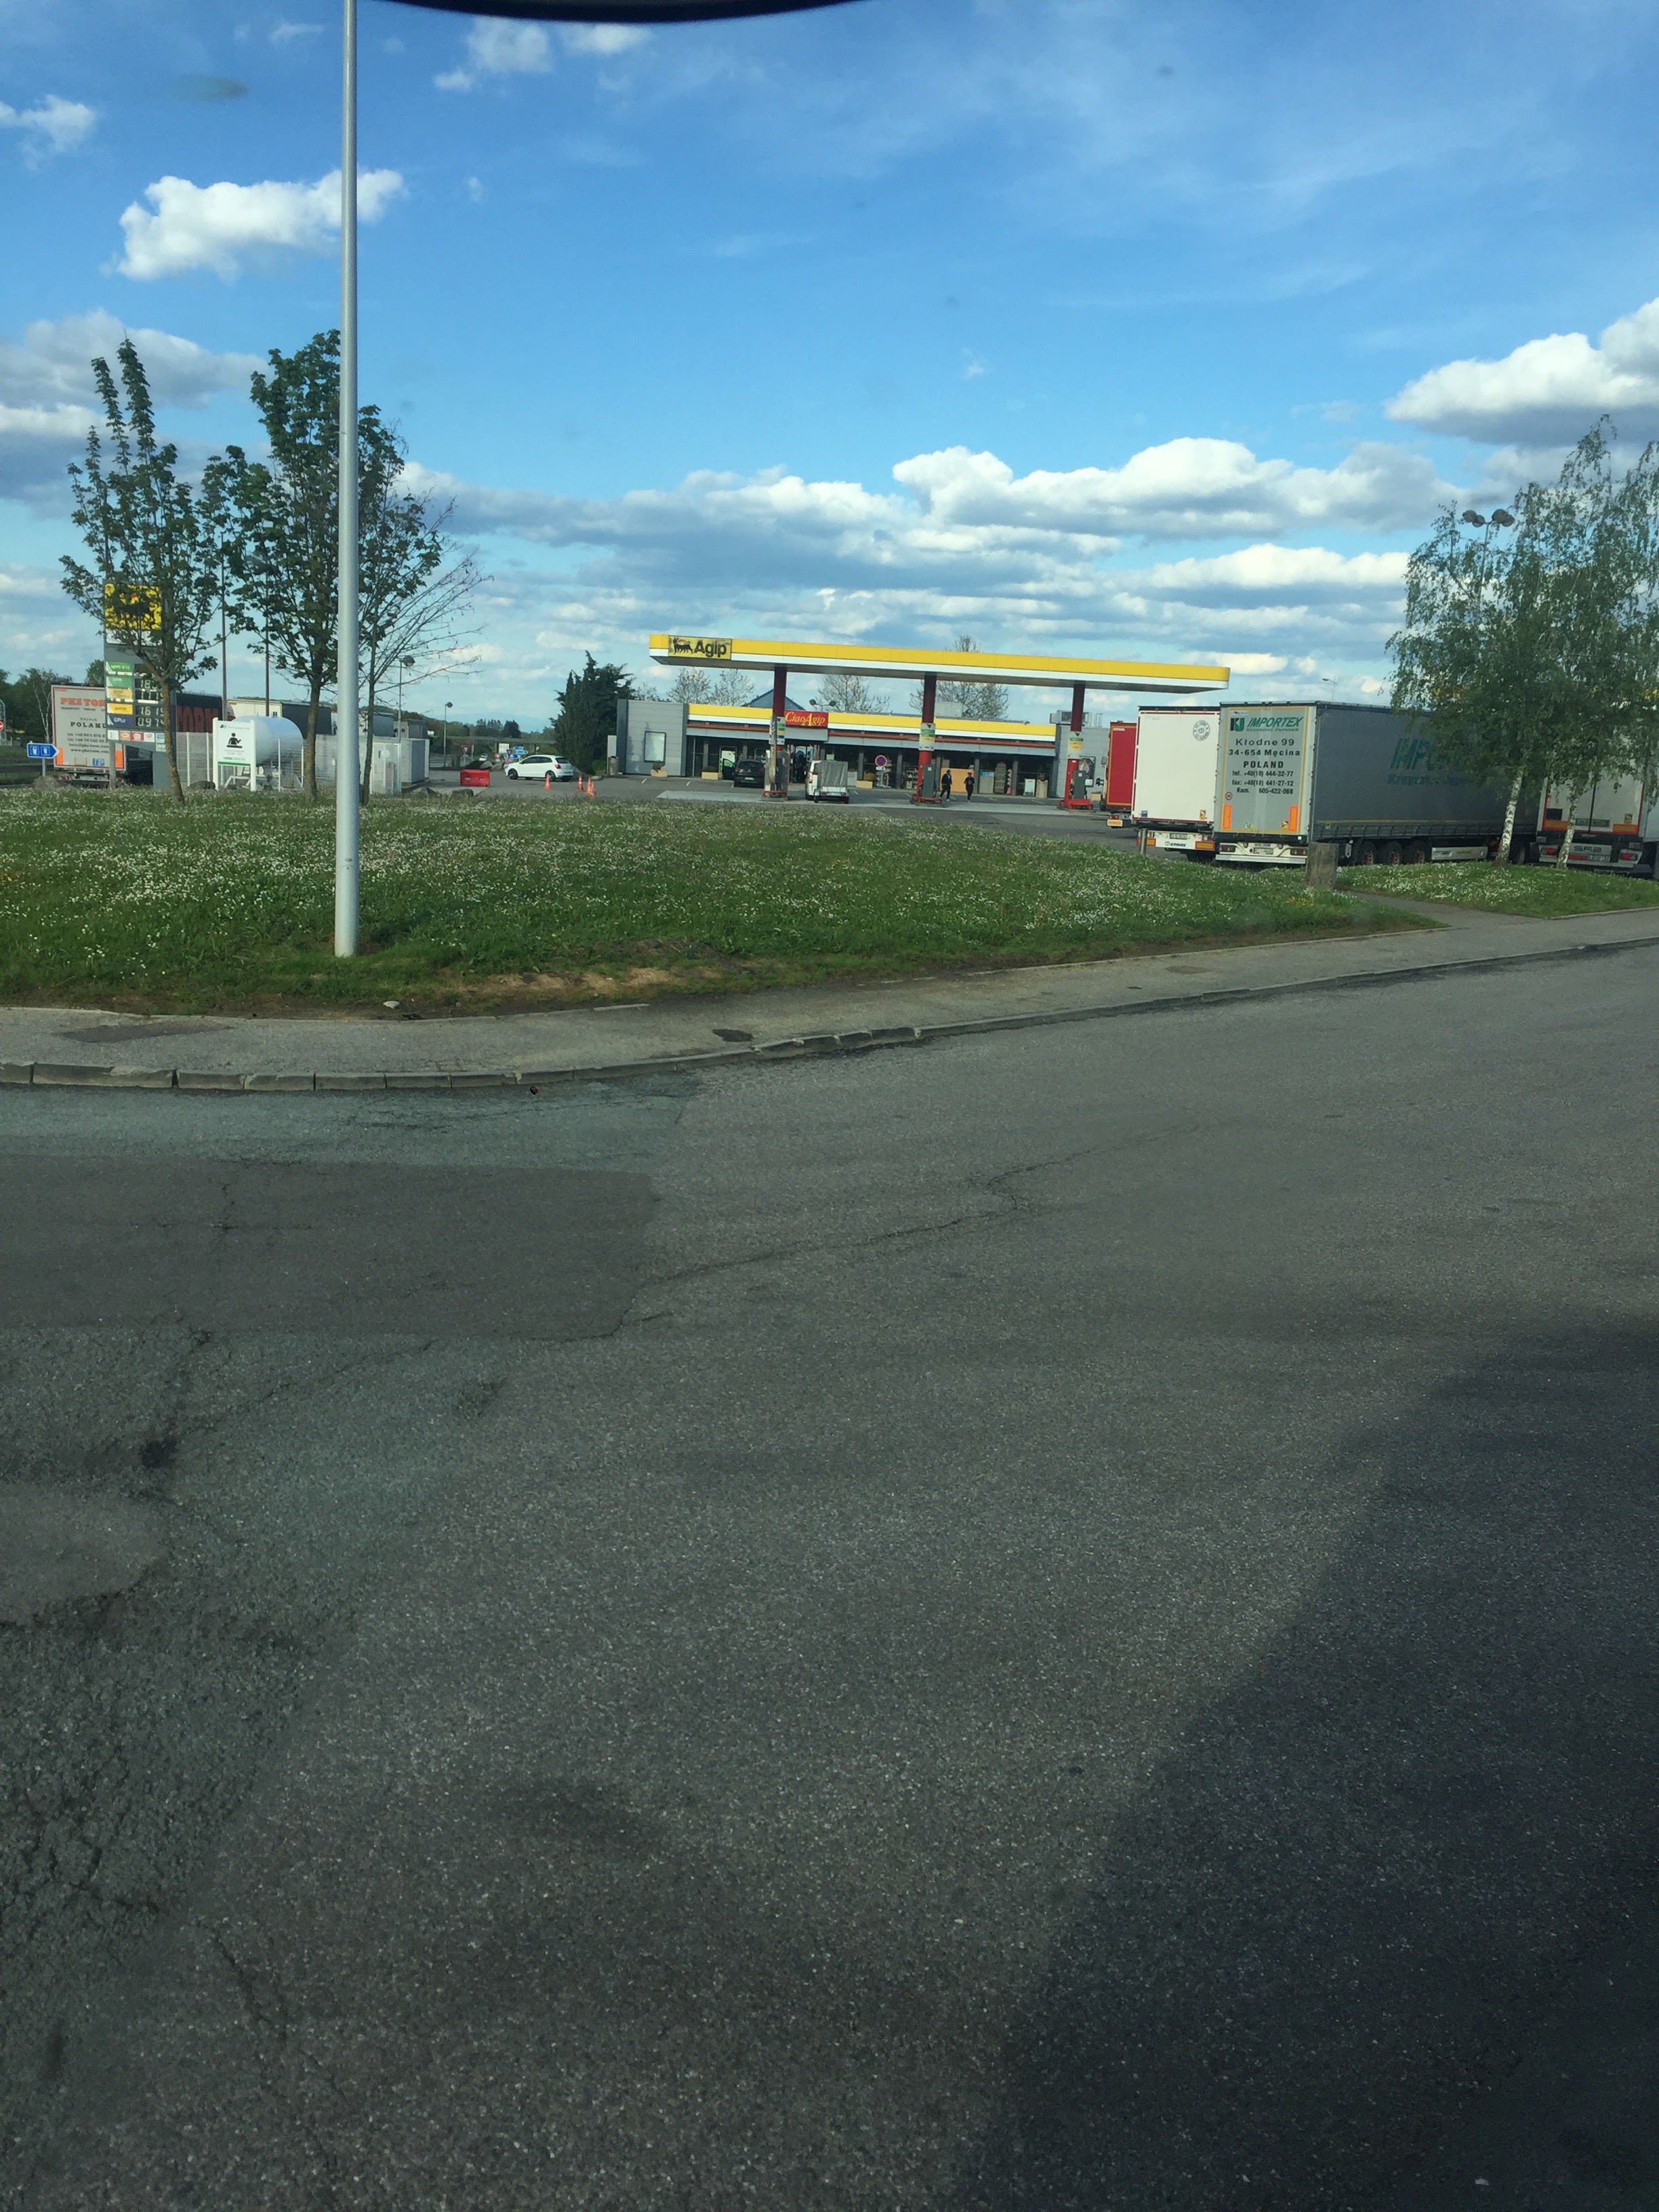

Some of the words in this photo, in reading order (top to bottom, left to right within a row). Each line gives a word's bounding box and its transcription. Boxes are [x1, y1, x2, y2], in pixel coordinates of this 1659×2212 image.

[694, 640, 726, 657] Agip
[1247, 717, 1304, 727] IMPORTEX
[1281, 738, 1294, 746] 99
[1243, 760, 1284, 769] POLAND
